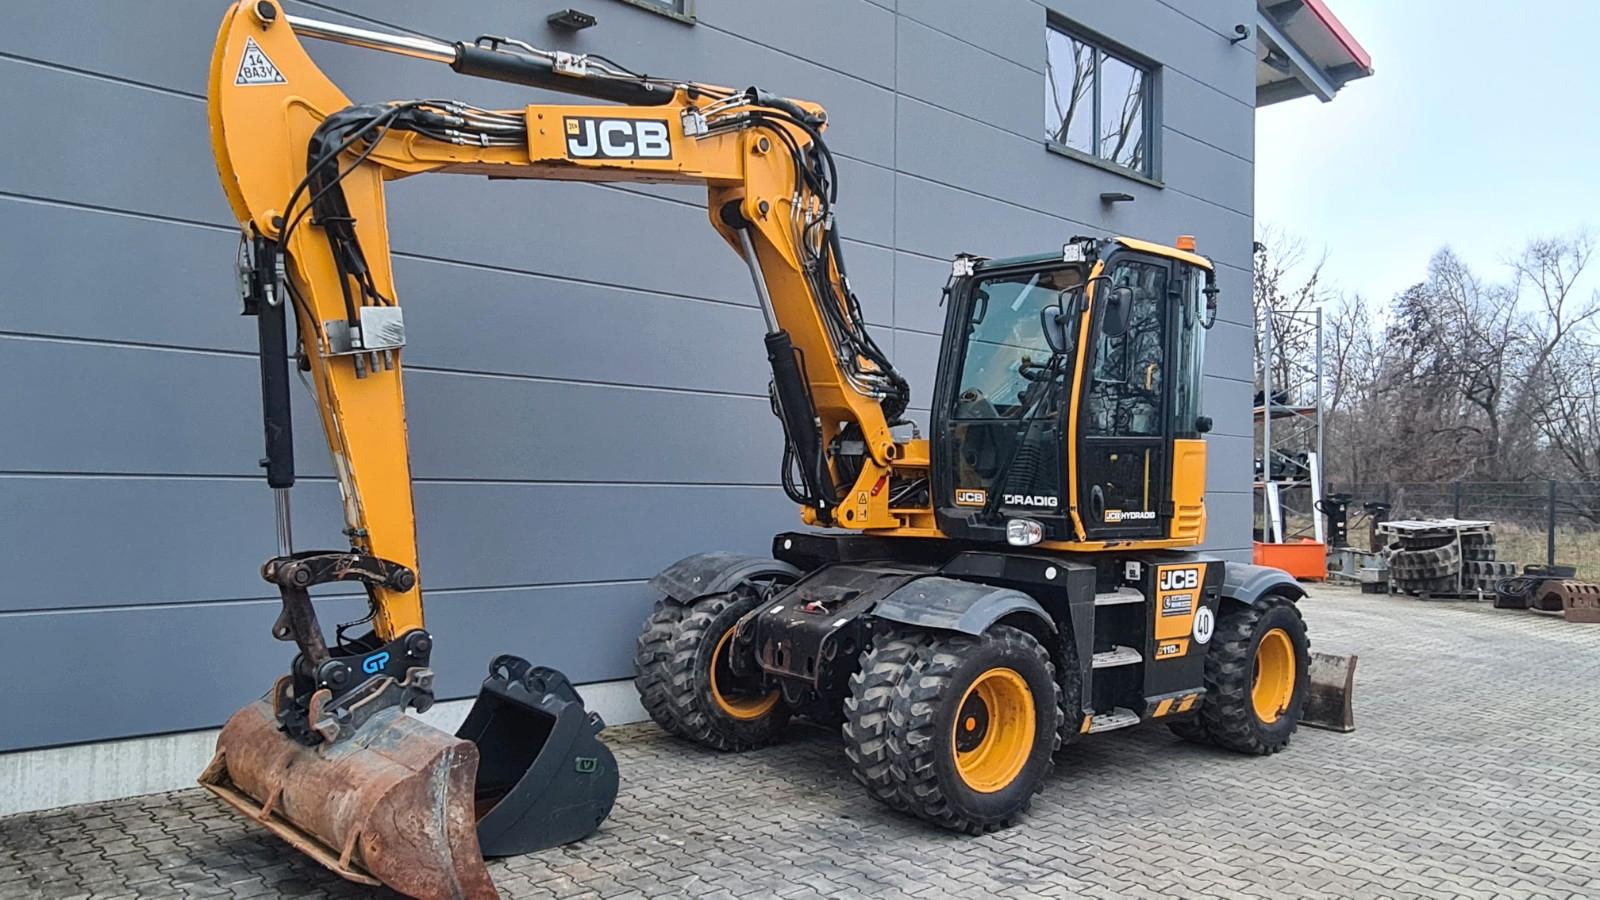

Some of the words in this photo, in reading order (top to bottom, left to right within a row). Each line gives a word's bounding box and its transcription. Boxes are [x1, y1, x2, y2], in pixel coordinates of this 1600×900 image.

[249, 54, 263, 66] 14
[568, 119, 670, 157] JCB
[958, 492, 983, 502] JCB
[1002, 494, 1058, 507] DRADIG
[1160, 569, 1198, 591] JCB
[1198, 614, 1209, 635] 40
[363, 652, 390, 673] GP
